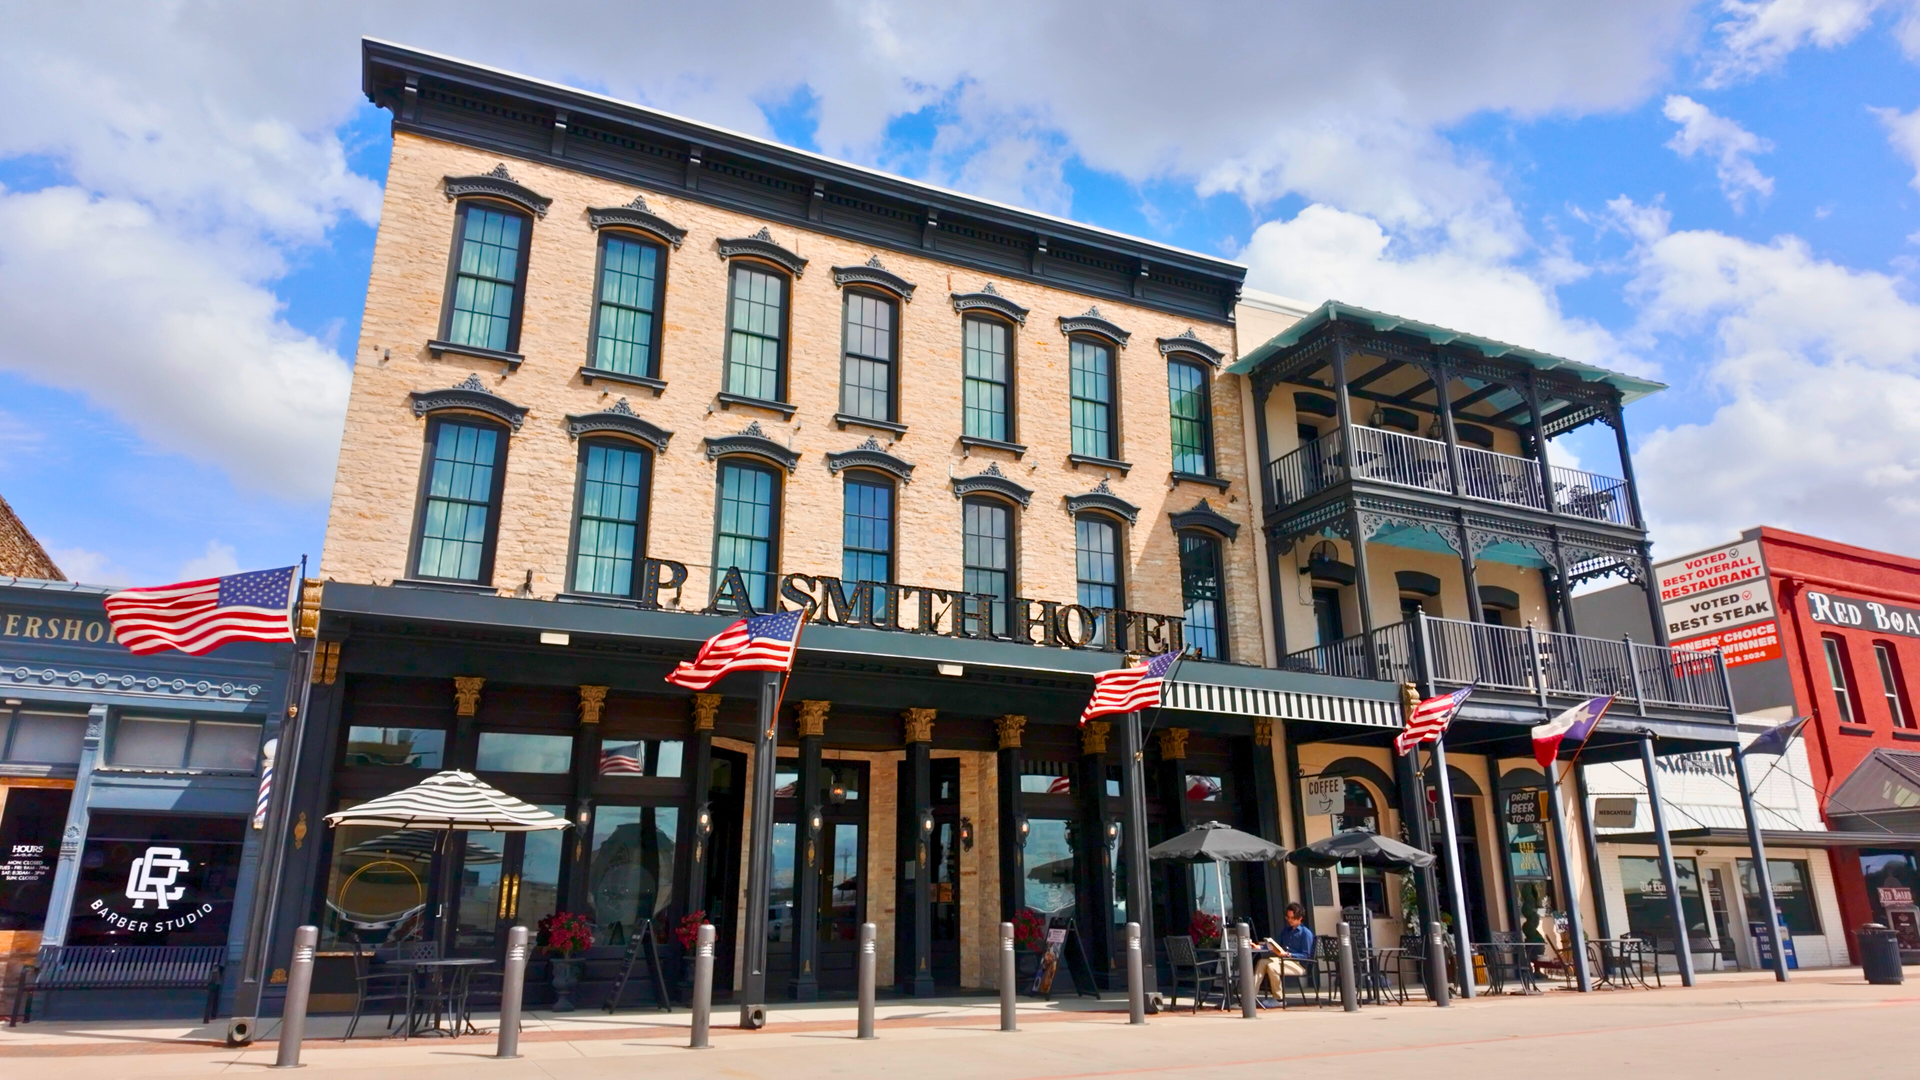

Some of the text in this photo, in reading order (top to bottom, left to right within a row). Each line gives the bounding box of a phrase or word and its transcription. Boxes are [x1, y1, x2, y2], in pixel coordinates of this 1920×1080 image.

[1685, 552, 1727, 570] VOTED
[1663, 556, 1756, 587] BEST OVERALL
[1661, 566, 1762, 600] RESTAURANT
[1690, 594, 1740, 613] VOTED
[780, 572, 1000, 643] SMITH
[1012, 597, 1202, 660] HOTEL
[1669, 601, 1770, 633] BEST STEAK
[1866, 602, 1920, 635] BOA
[0, 614, 116, 644] ERSHO
[1723, 624, 1776, 643] CHOICE
[1721, 635, 1777, 655] WINNER
[1743, 651, 1766, 661] 2024
[1308, 779, 1339, 795] COFFEE
[1511, 792, 1536, 802] DRAFT
[1511, 803, 1535, 814] BEER
[1511, 814, 1535, 823] TO-GO
[12, 845, 44, 853] HOURS
[90, 899, 213, 932] BARBER STUDIO
